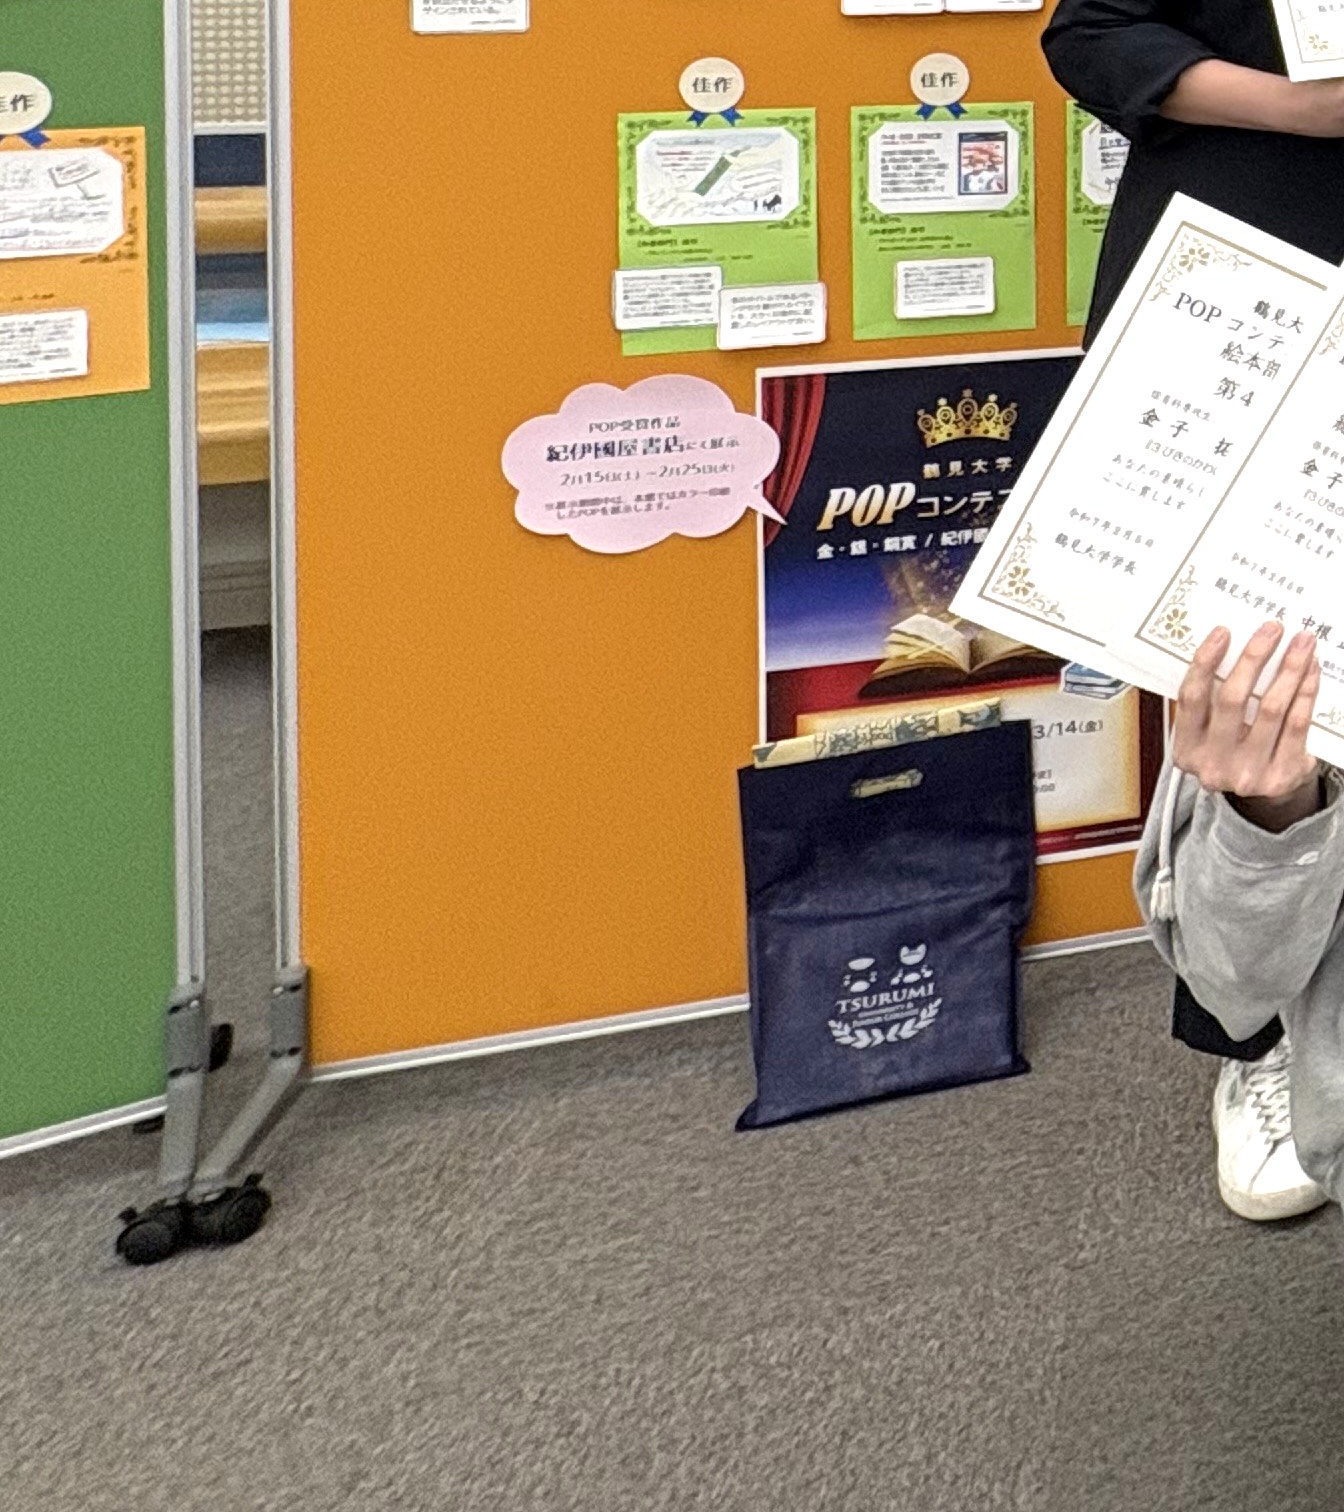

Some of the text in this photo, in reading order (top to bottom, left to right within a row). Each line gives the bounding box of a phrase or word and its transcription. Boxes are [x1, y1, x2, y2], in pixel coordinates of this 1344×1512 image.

[692, 76, 734, 93] 佳作
[920, 71, 960, 88] 佳作
[1174, 291, 1286, 350] POP コンテ
[1220, 341, 1282, 381] 絵本部
[1139, 408, 1189, 439] 金子
[1299, 458, 1344, 489] 金子
[816, 482, 1013, 531] POPコンテ
[835, 982, 936, 1014] TSURUMI
